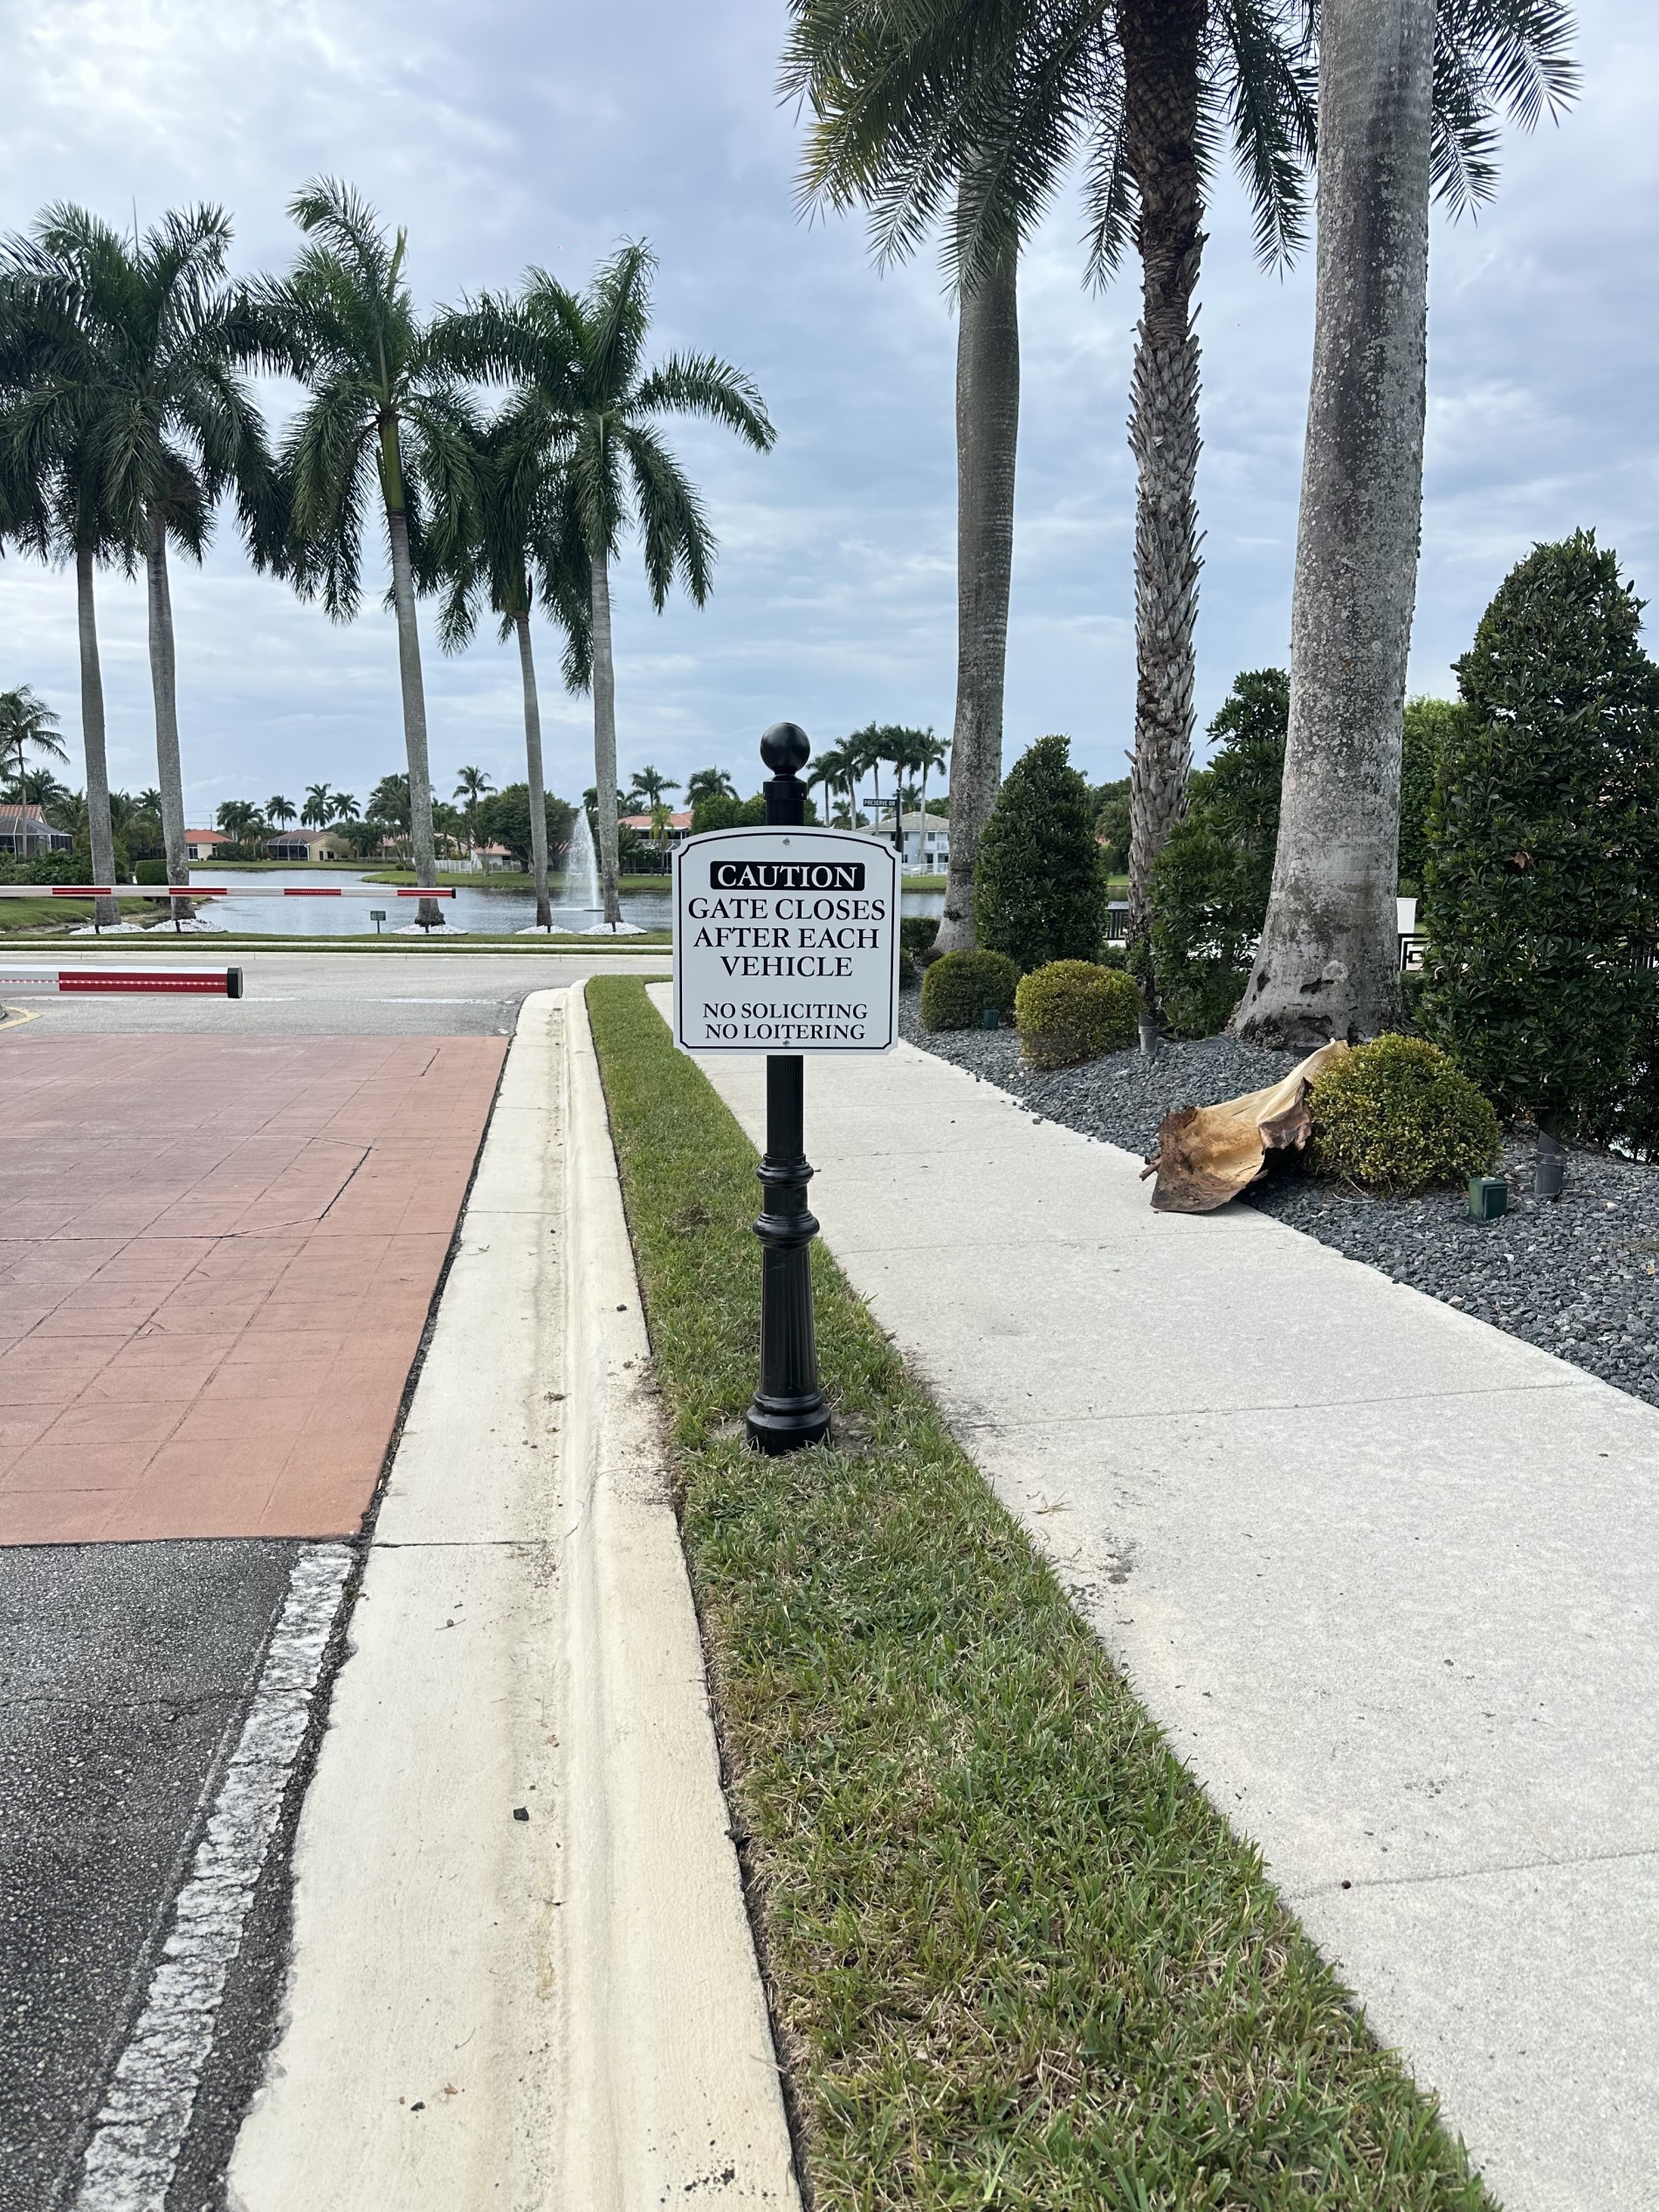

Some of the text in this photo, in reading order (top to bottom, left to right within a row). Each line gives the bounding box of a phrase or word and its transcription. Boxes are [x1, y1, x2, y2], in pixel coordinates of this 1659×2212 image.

[718, 865, 857, 888] CAUTION
[688, 897, 885, 920] GATE CLOSES
[693, 926, 880, 949] AFTER EACH
[719, 955, 853, 977] VEHICLE
[702, 1003, 868, 1020] NO SOLICITING
[705, 1023, 865, 1040] NO LOITERING
